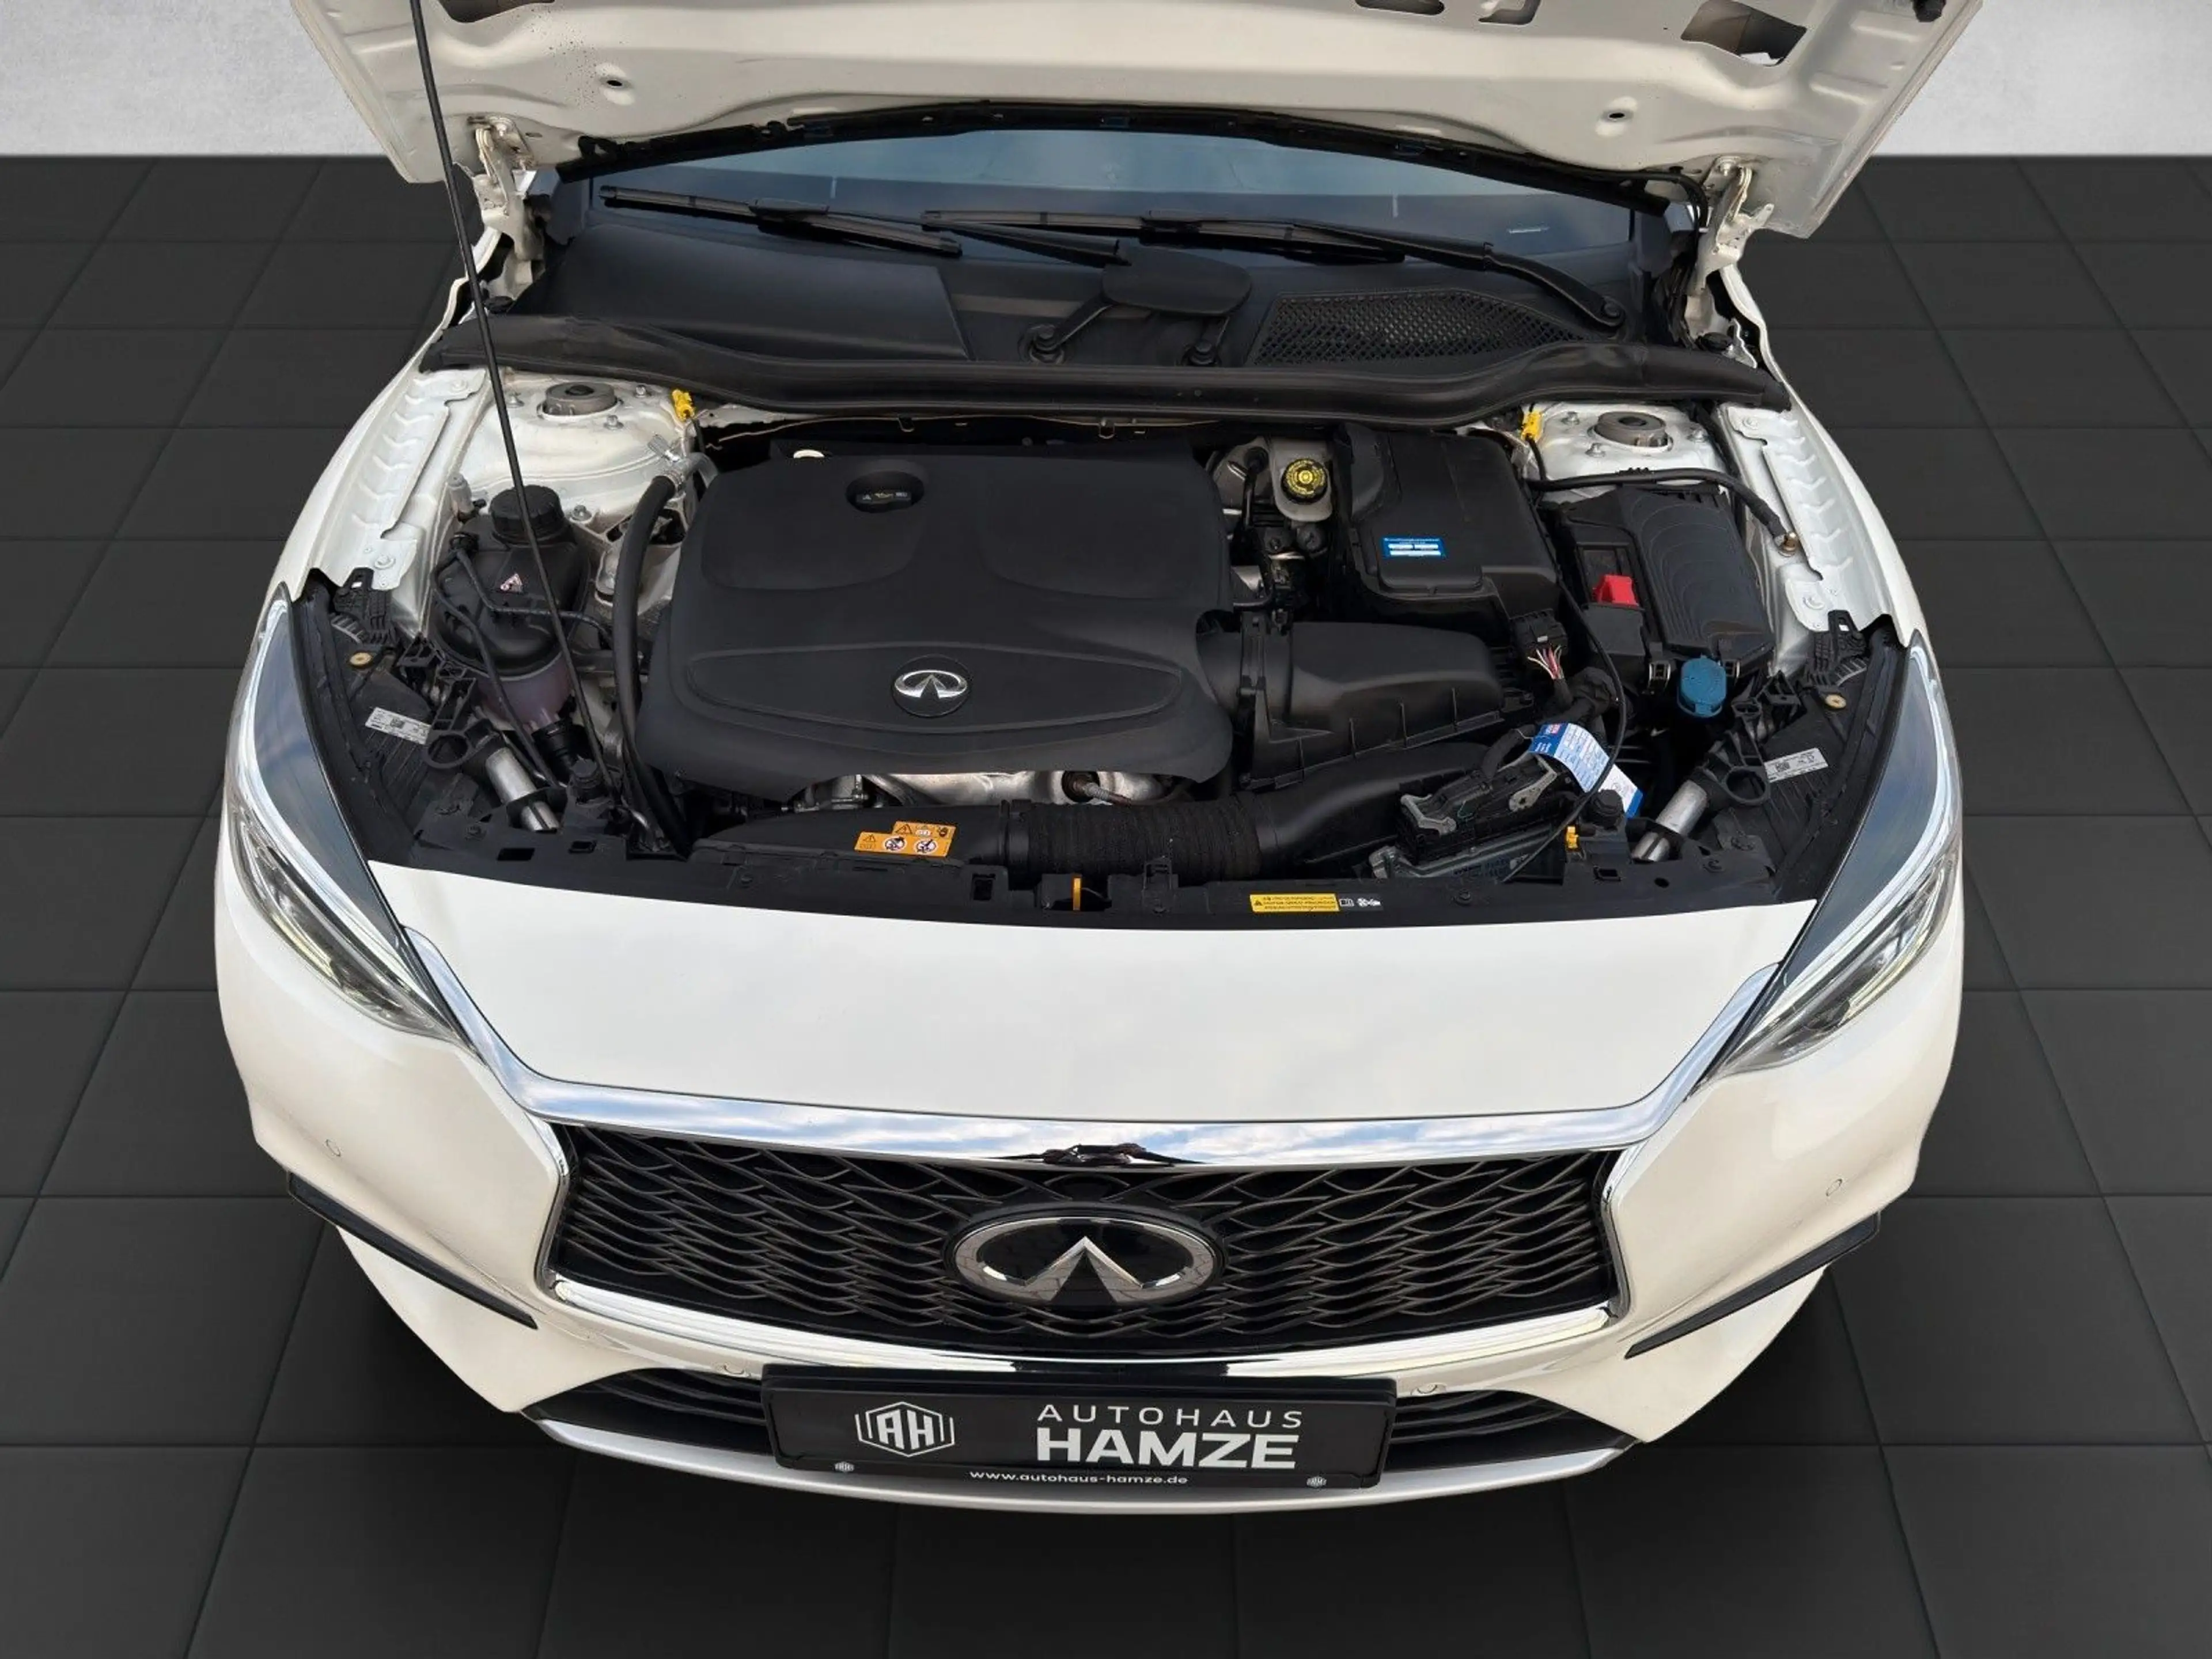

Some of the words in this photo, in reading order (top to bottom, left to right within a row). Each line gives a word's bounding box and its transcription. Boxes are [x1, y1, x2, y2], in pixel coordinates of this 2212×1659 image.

[876, 1409, 935, 1450] AH
[1037, 1404, 1302, 1429] AUTOHAUS
[1037, 1427, 1300, 1469] HAMZE
[969, 1471, 1188, 1484] www.autohaus-hamze.de
